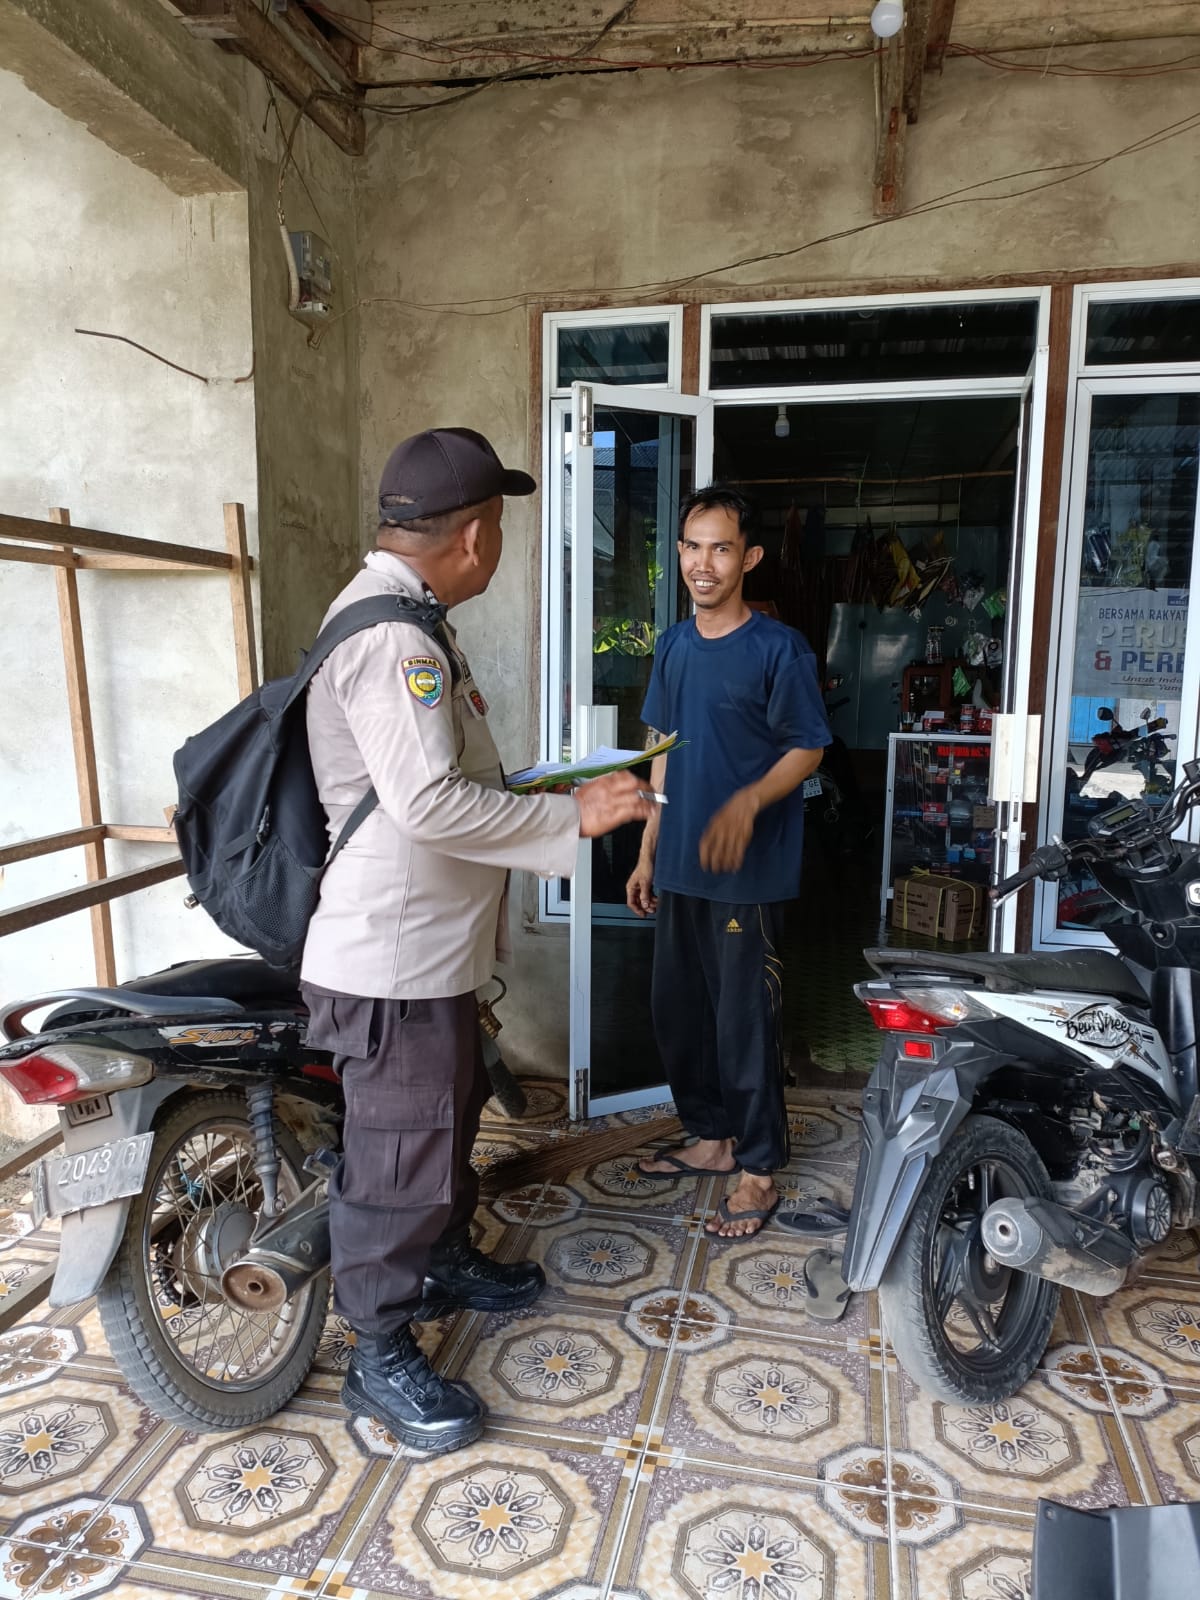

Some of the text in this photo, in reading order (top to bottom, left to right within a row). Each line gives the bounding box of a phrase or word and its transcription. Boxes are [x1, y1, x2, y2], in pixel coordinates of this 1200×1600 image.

[1098, 607, 1188, 621] BERSAMA RAKYAT
[407, 658, 438, 668] BINMAS
[1094, 650, 1113, 671] &
[168, 1027, 255, 1044] Supra
[56, 1149, 112, 1186] 2043
